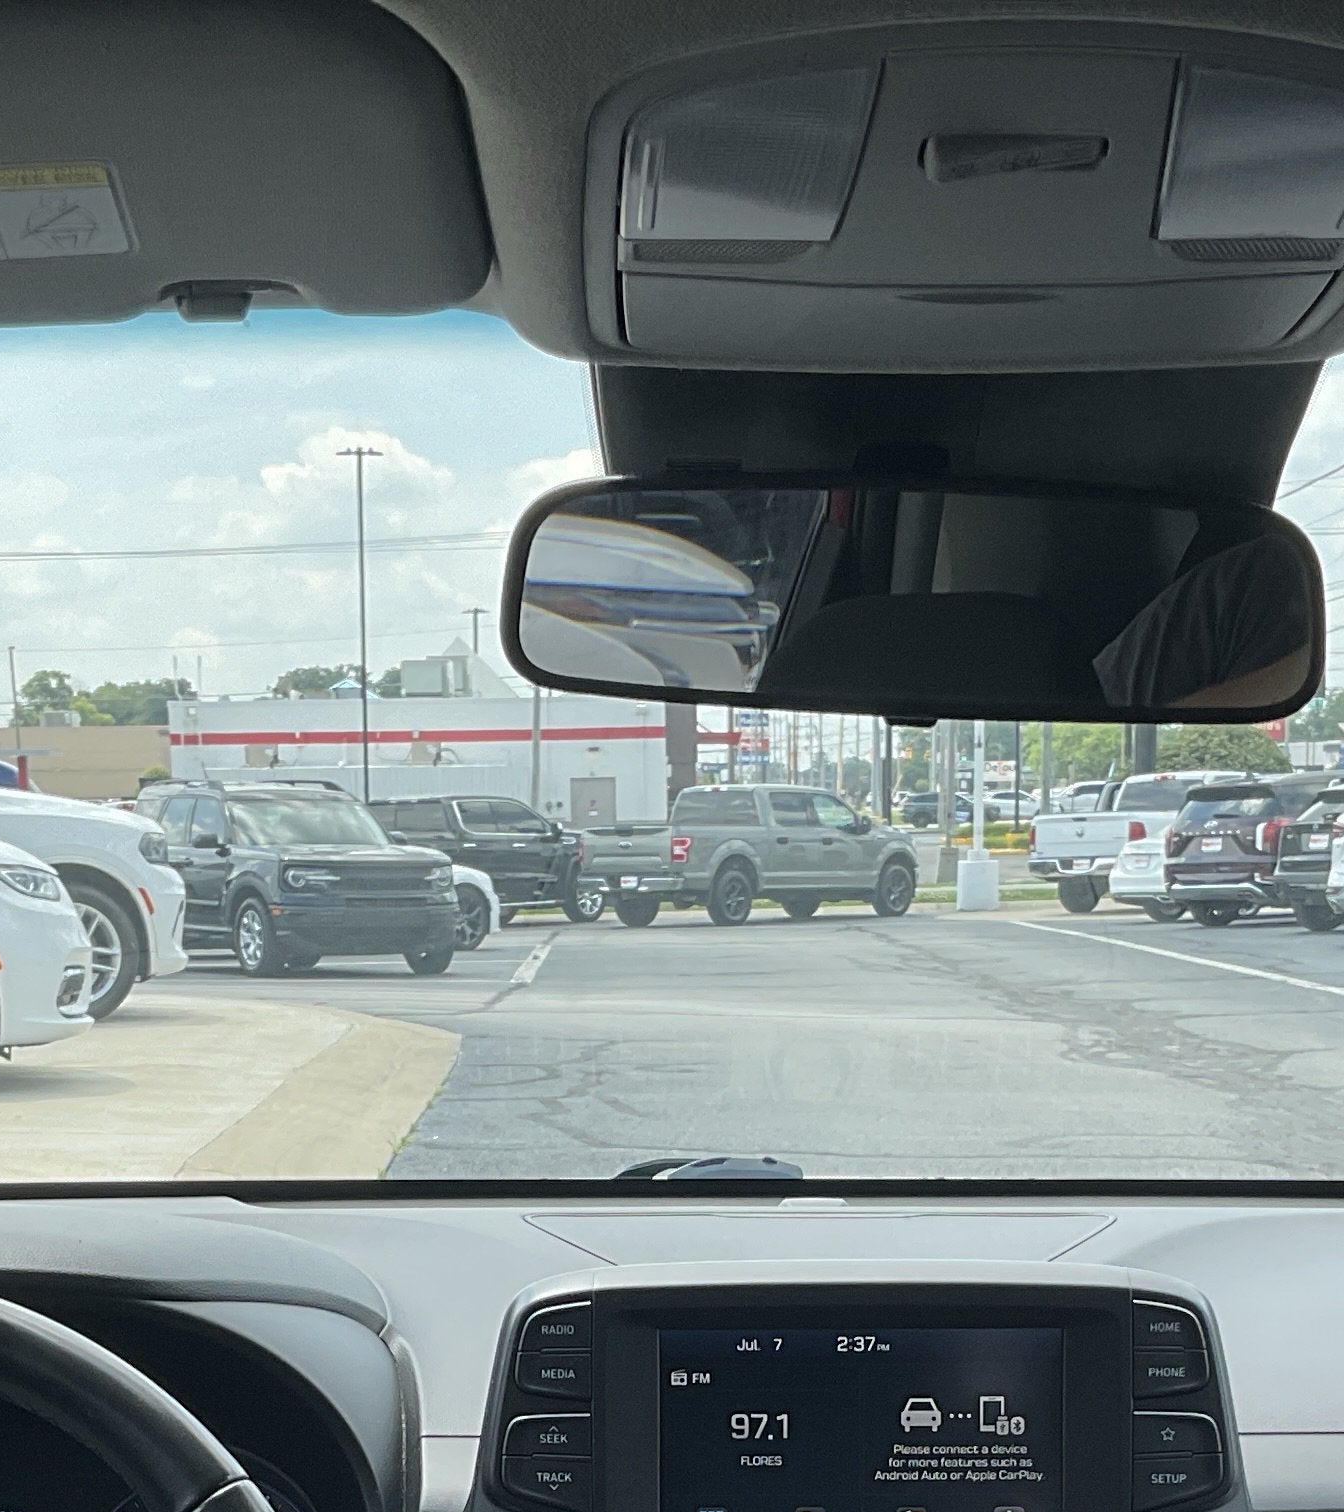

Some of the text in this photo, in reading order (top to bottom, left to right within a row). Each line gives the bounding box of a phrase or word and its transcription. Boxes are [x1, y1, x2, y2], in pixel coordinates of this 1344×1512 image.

[541, 1325, 574, 1335] RADIO
[1150, 1322, 1181, 1332] HOME
[773, 1339, 782, 1351] 7
[541, 1369, 575, 1379] MEDIA
[1148, 1367, 1186, 1377] PHONE
[692, 1373, 711, 1384] FM
[730, 1413, 789, 1440] 97.1
[540, 1434, 568, 1443] SEEK
[893, 1444, 930, 1454] Please
[932, 1445, 978, 1454] connect
[991, 1444, 1028, 1454] device
[740, 1456, 782, 1466] FLORES
[888, 1457, 1033, 1468] for more features such as
[537, 1472, 572, 1482] TRACK
[874, 1471, 918, 1481] Android
[921, 1471, 948, 1481] Auto
[950, 1473, 963, 1481] or
[965, 1471, 997, 1482] Apple
[1152, 1473, 1187, 1484] SETUP
